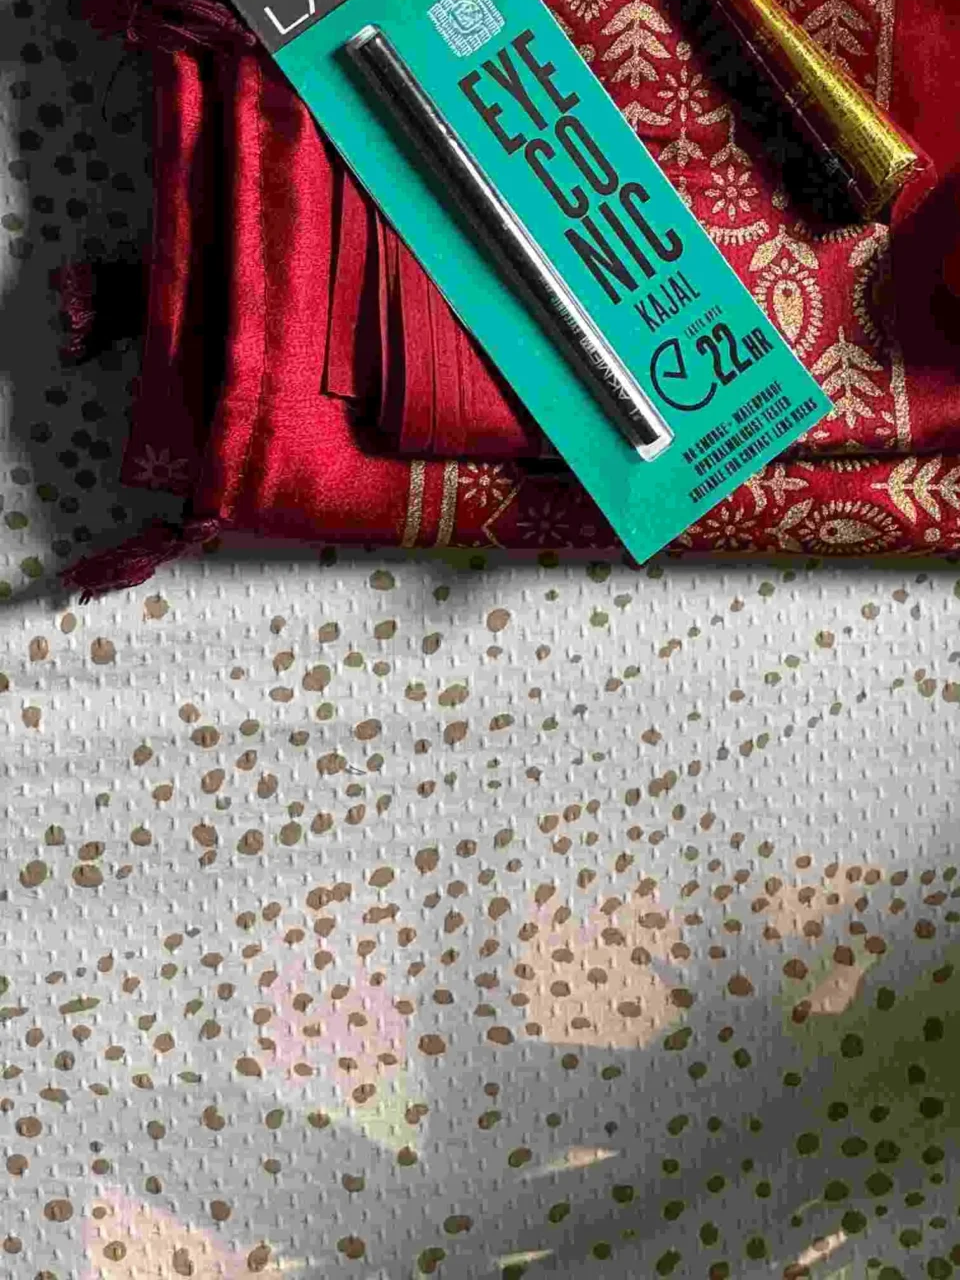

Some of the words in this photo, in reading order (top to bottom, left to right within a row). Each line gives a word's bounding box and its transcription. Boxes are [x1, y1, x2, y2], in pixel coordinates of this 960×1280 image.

[457, 28, 580, 156] EYE
[524, 115, 619, 219] CO
[564, 182, 684, 305] NIC
[634, 271, 700, 332] KAJAL
[688, 470, 727, 504] SUITABLE
[724, 455, 744, 473] FOR
[740, 428, 773, 463] CONTACT
[774, 414, 794, 438] LENS
[790, 397, 818, 424] USERS
